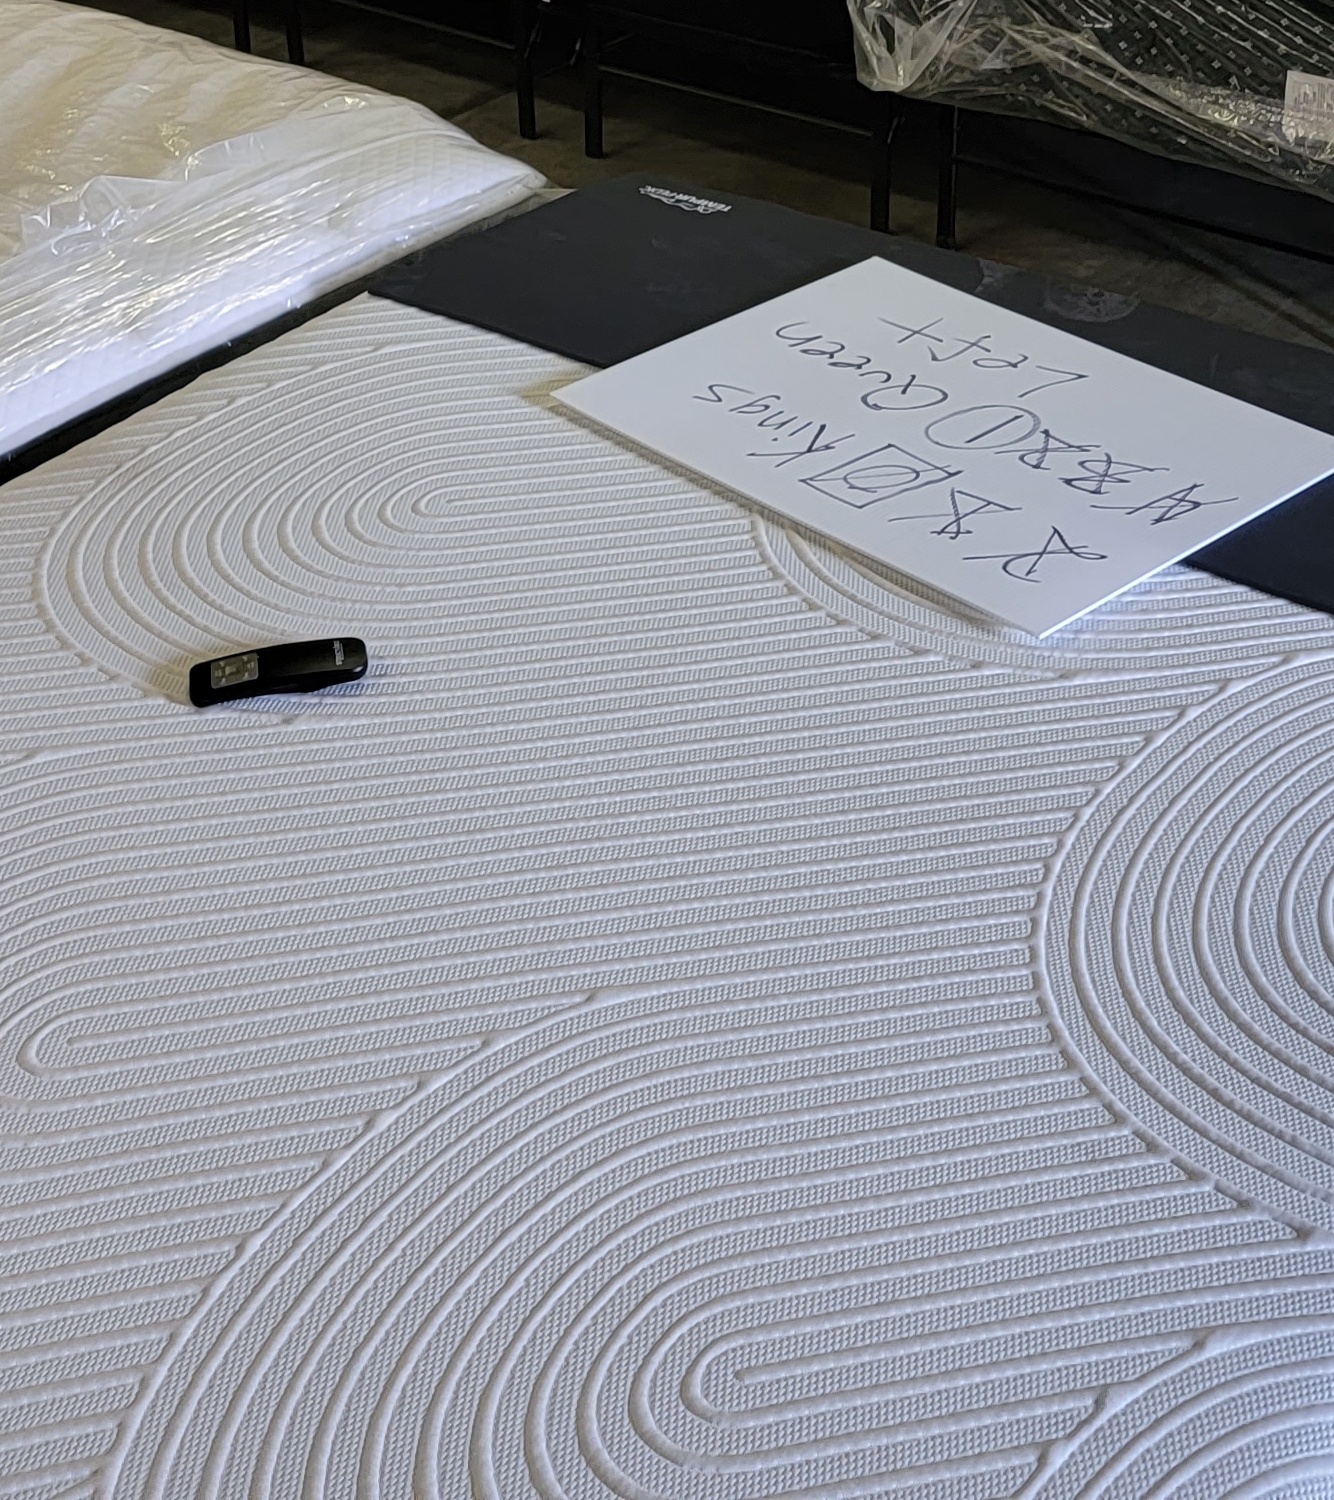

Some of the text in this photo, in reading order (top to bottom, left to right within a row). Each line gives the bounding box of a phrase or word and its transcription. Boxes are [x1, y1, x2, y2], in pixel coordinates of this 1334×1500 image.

[775, 320, 948, 411] Queen
[877, 316, 1088, 397] Left
[691, 383, 856, 469] Kings
